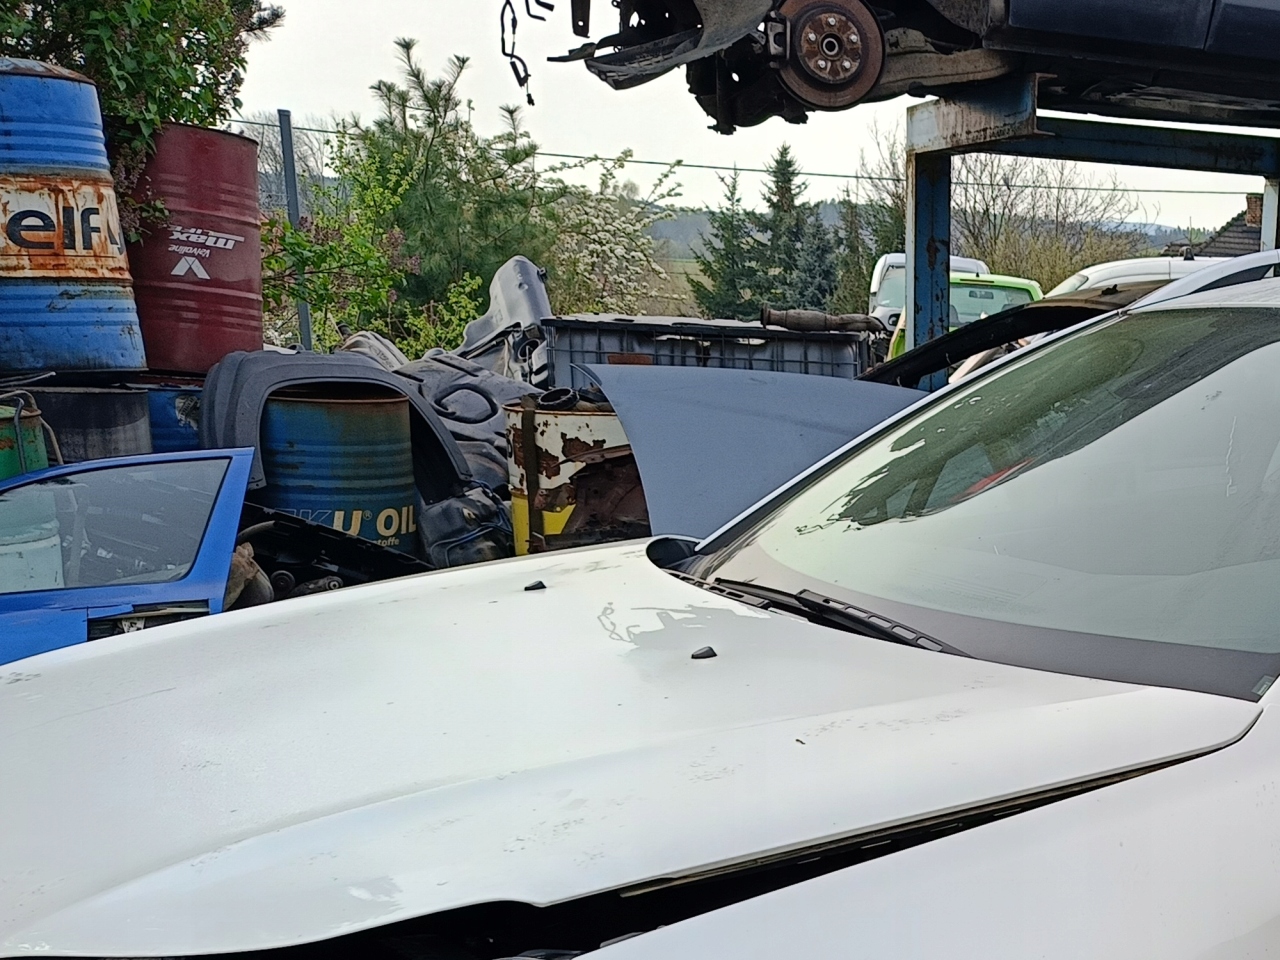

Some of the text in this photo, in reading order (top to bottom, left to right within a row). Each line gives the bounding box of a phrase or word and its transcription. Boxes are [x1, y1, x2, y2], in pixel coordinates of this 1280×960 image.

[6, 206, 101, 250] elf
[168, 244, 211, 258] Valvoline
[376, 505, 417, 537] OIL
